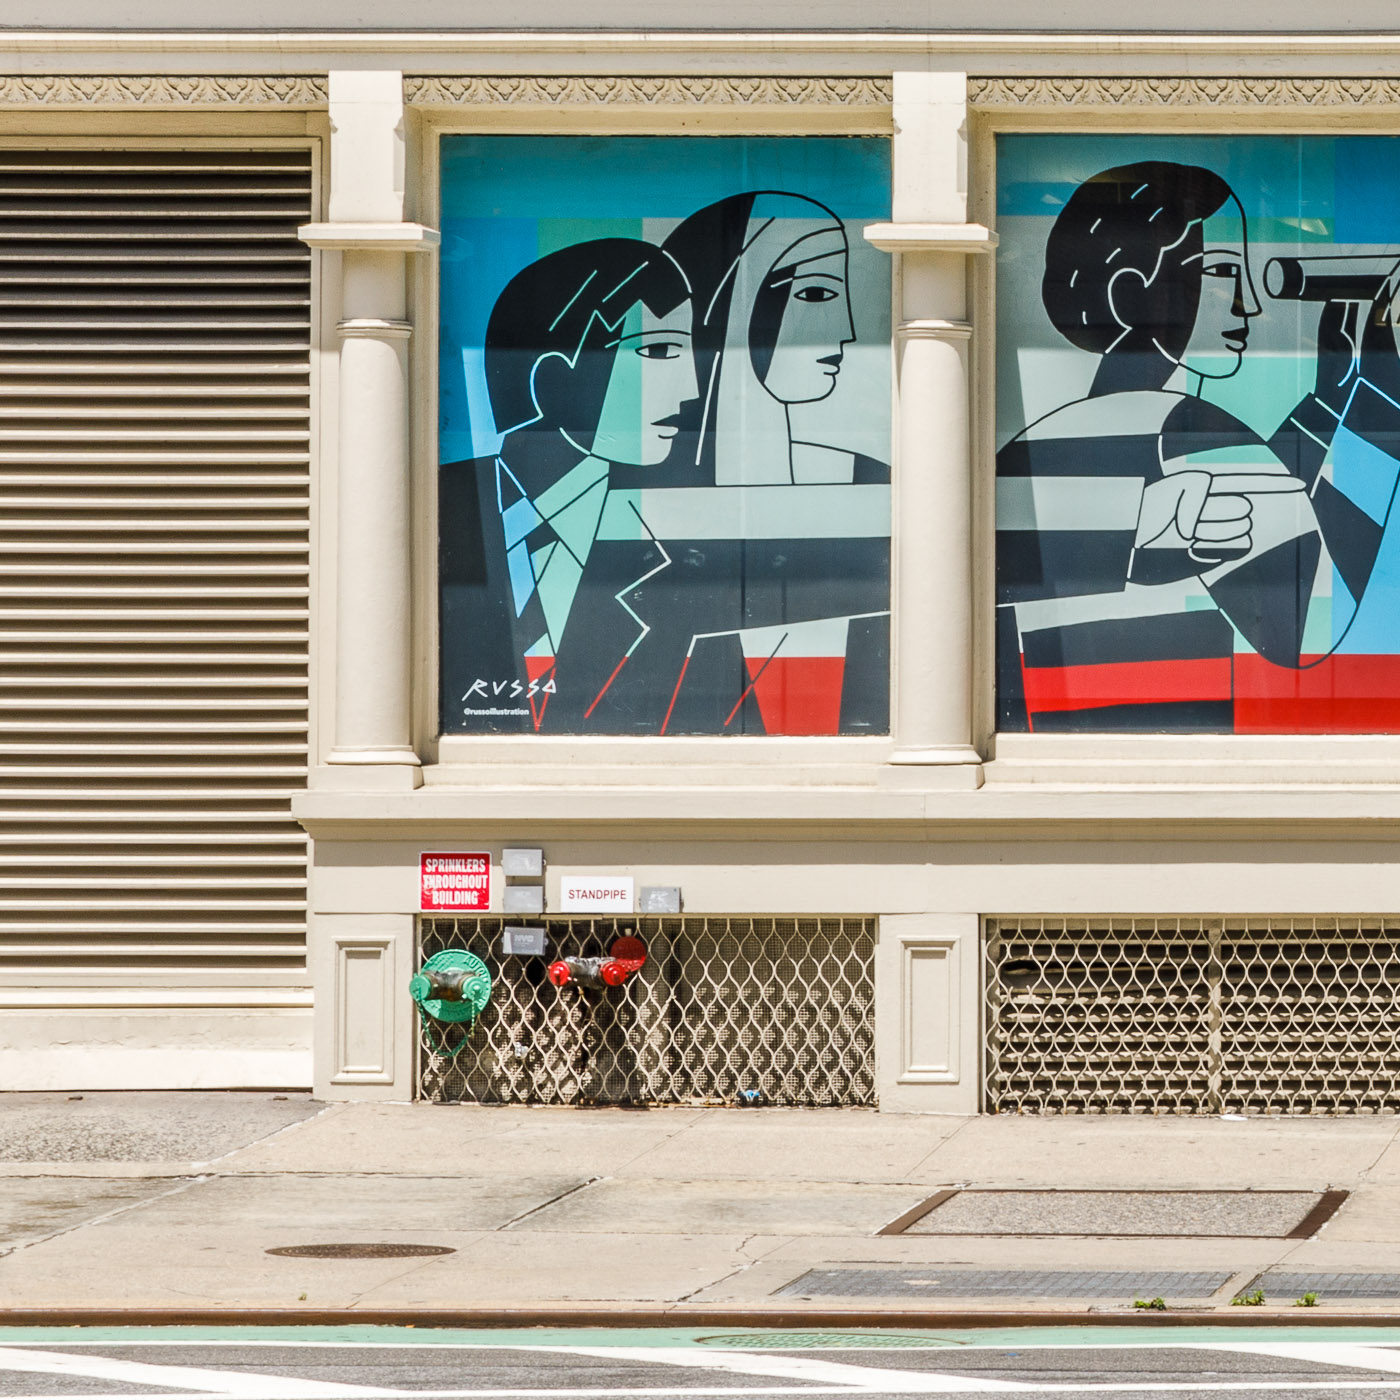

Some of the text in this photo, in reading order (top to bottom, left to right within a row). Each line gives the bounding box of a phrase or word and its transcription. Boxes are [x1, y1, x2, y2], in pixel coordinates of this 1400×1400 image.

[425, 858, 486, 873] SPRINKLERS
[423, 874, 488, 889] THROUGHOUT
[432, 890, 479, 905] BUILDING
[568, 889, 627, 900] STANDPIPE
